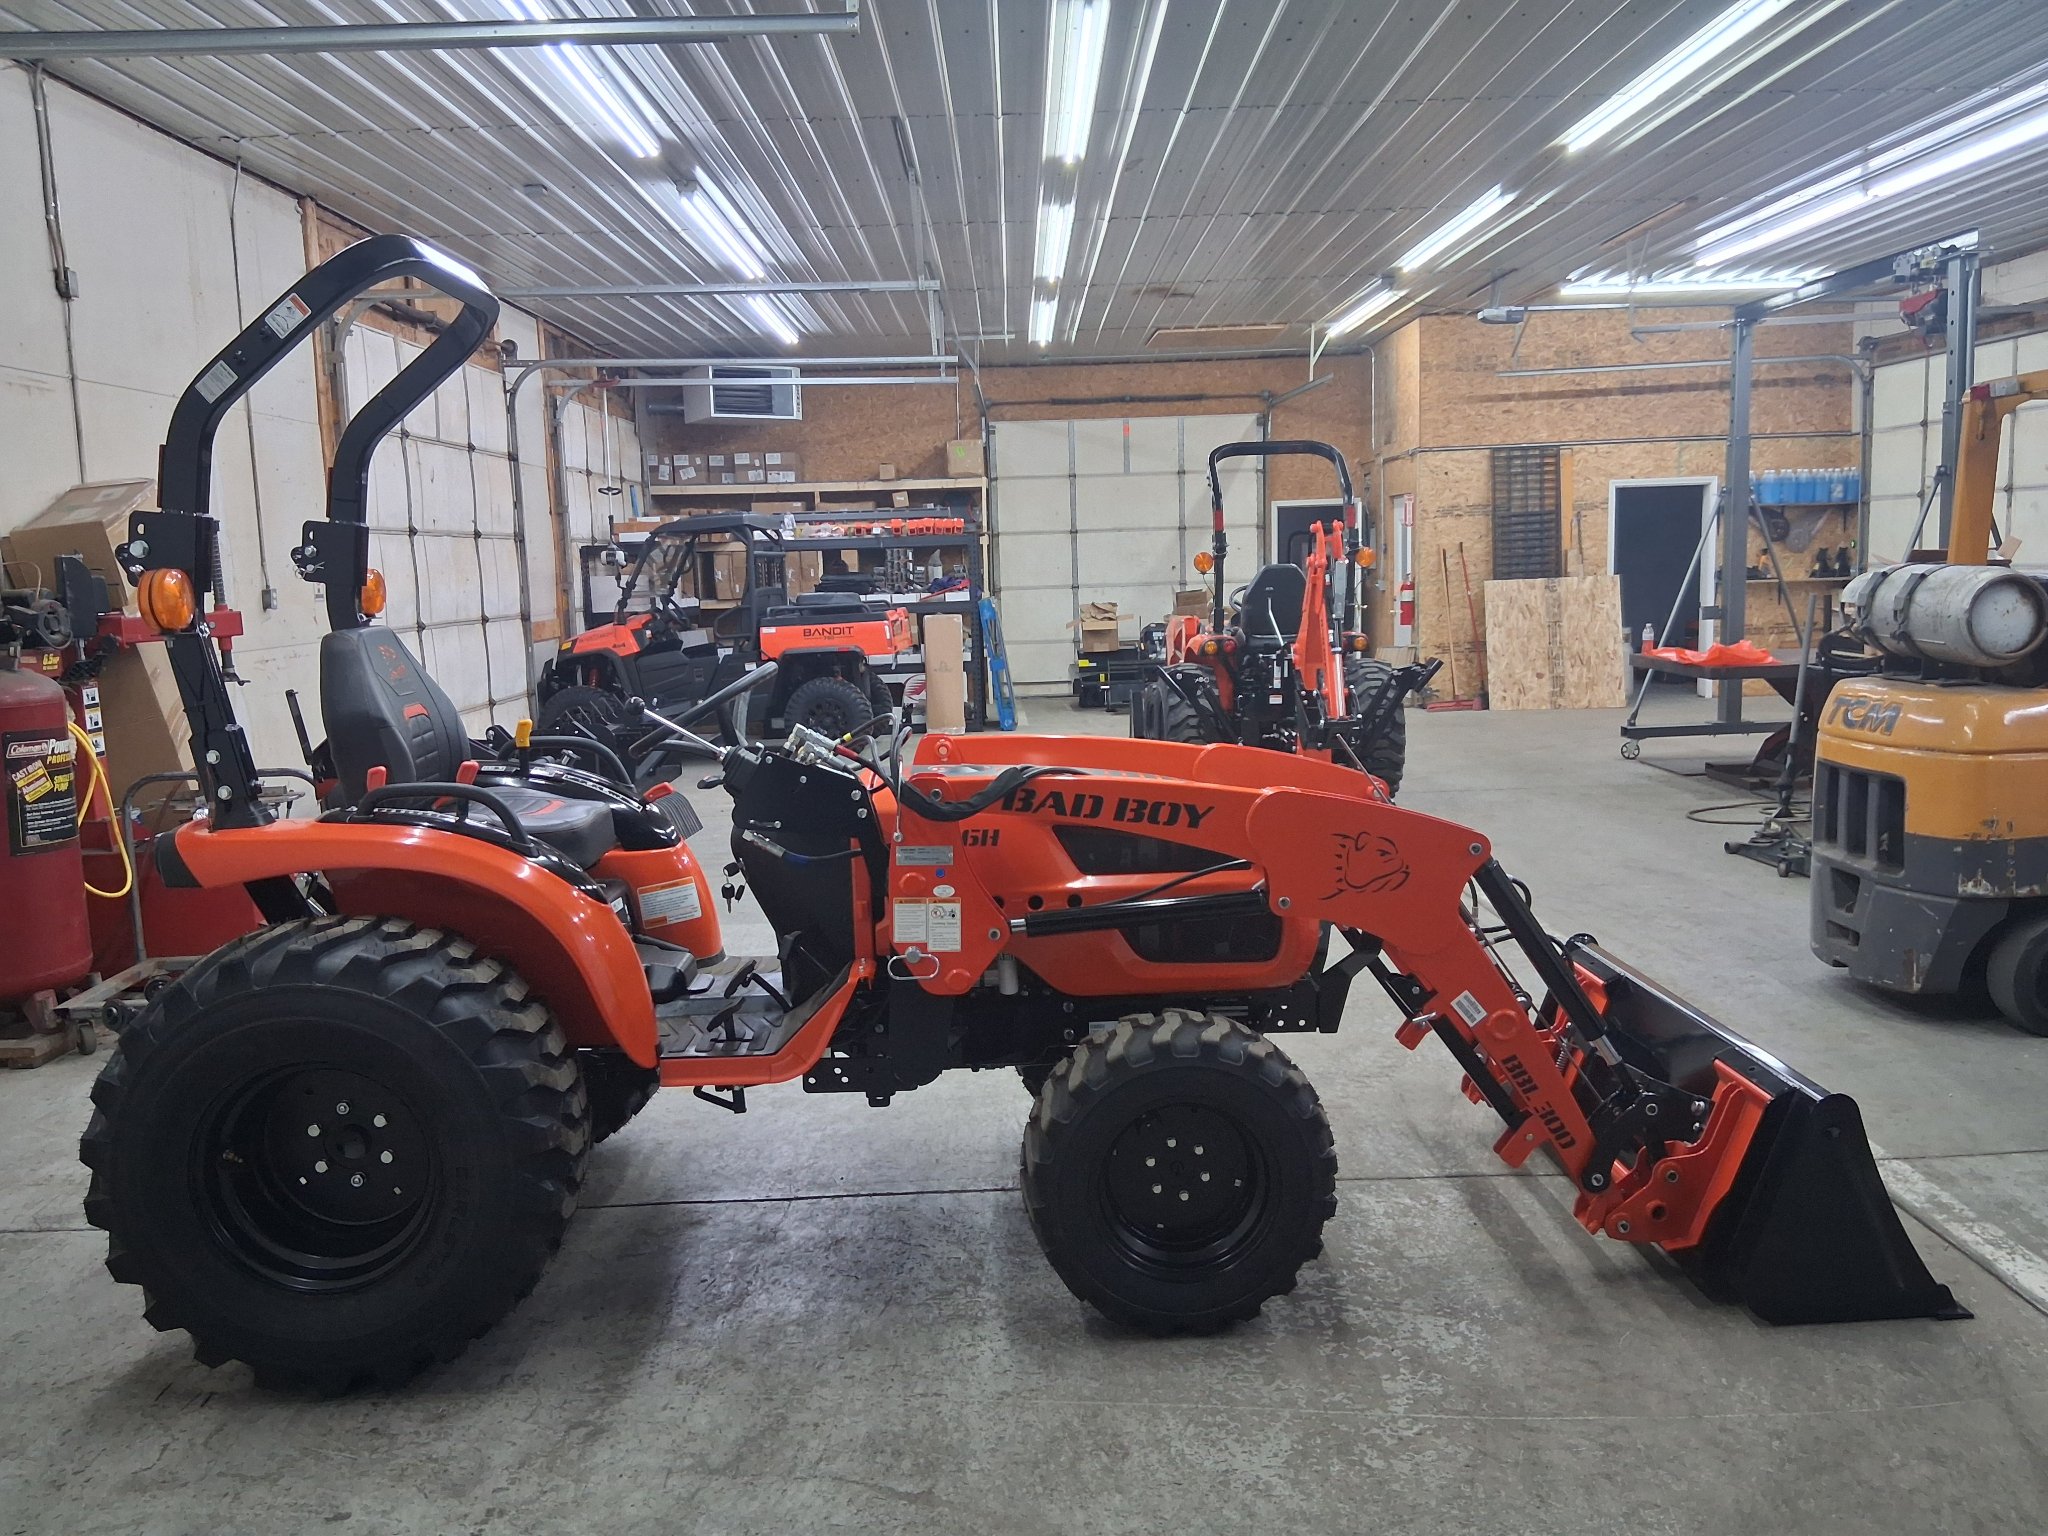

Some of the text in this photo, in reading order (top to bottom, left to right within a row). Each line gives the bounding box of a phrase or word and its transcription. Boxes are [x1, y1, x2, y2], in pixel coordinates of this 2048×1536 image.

[803, 626, 854, 637] BANDIT
[1827, 696, 1904, 736] TCM
[10, 742, 45, 755] Coleman
[11, 767, 28, 781] CAST
[1000, 788, 1215, 829] BAD BOY
[1533, 1101, 1576, 1149] 300
